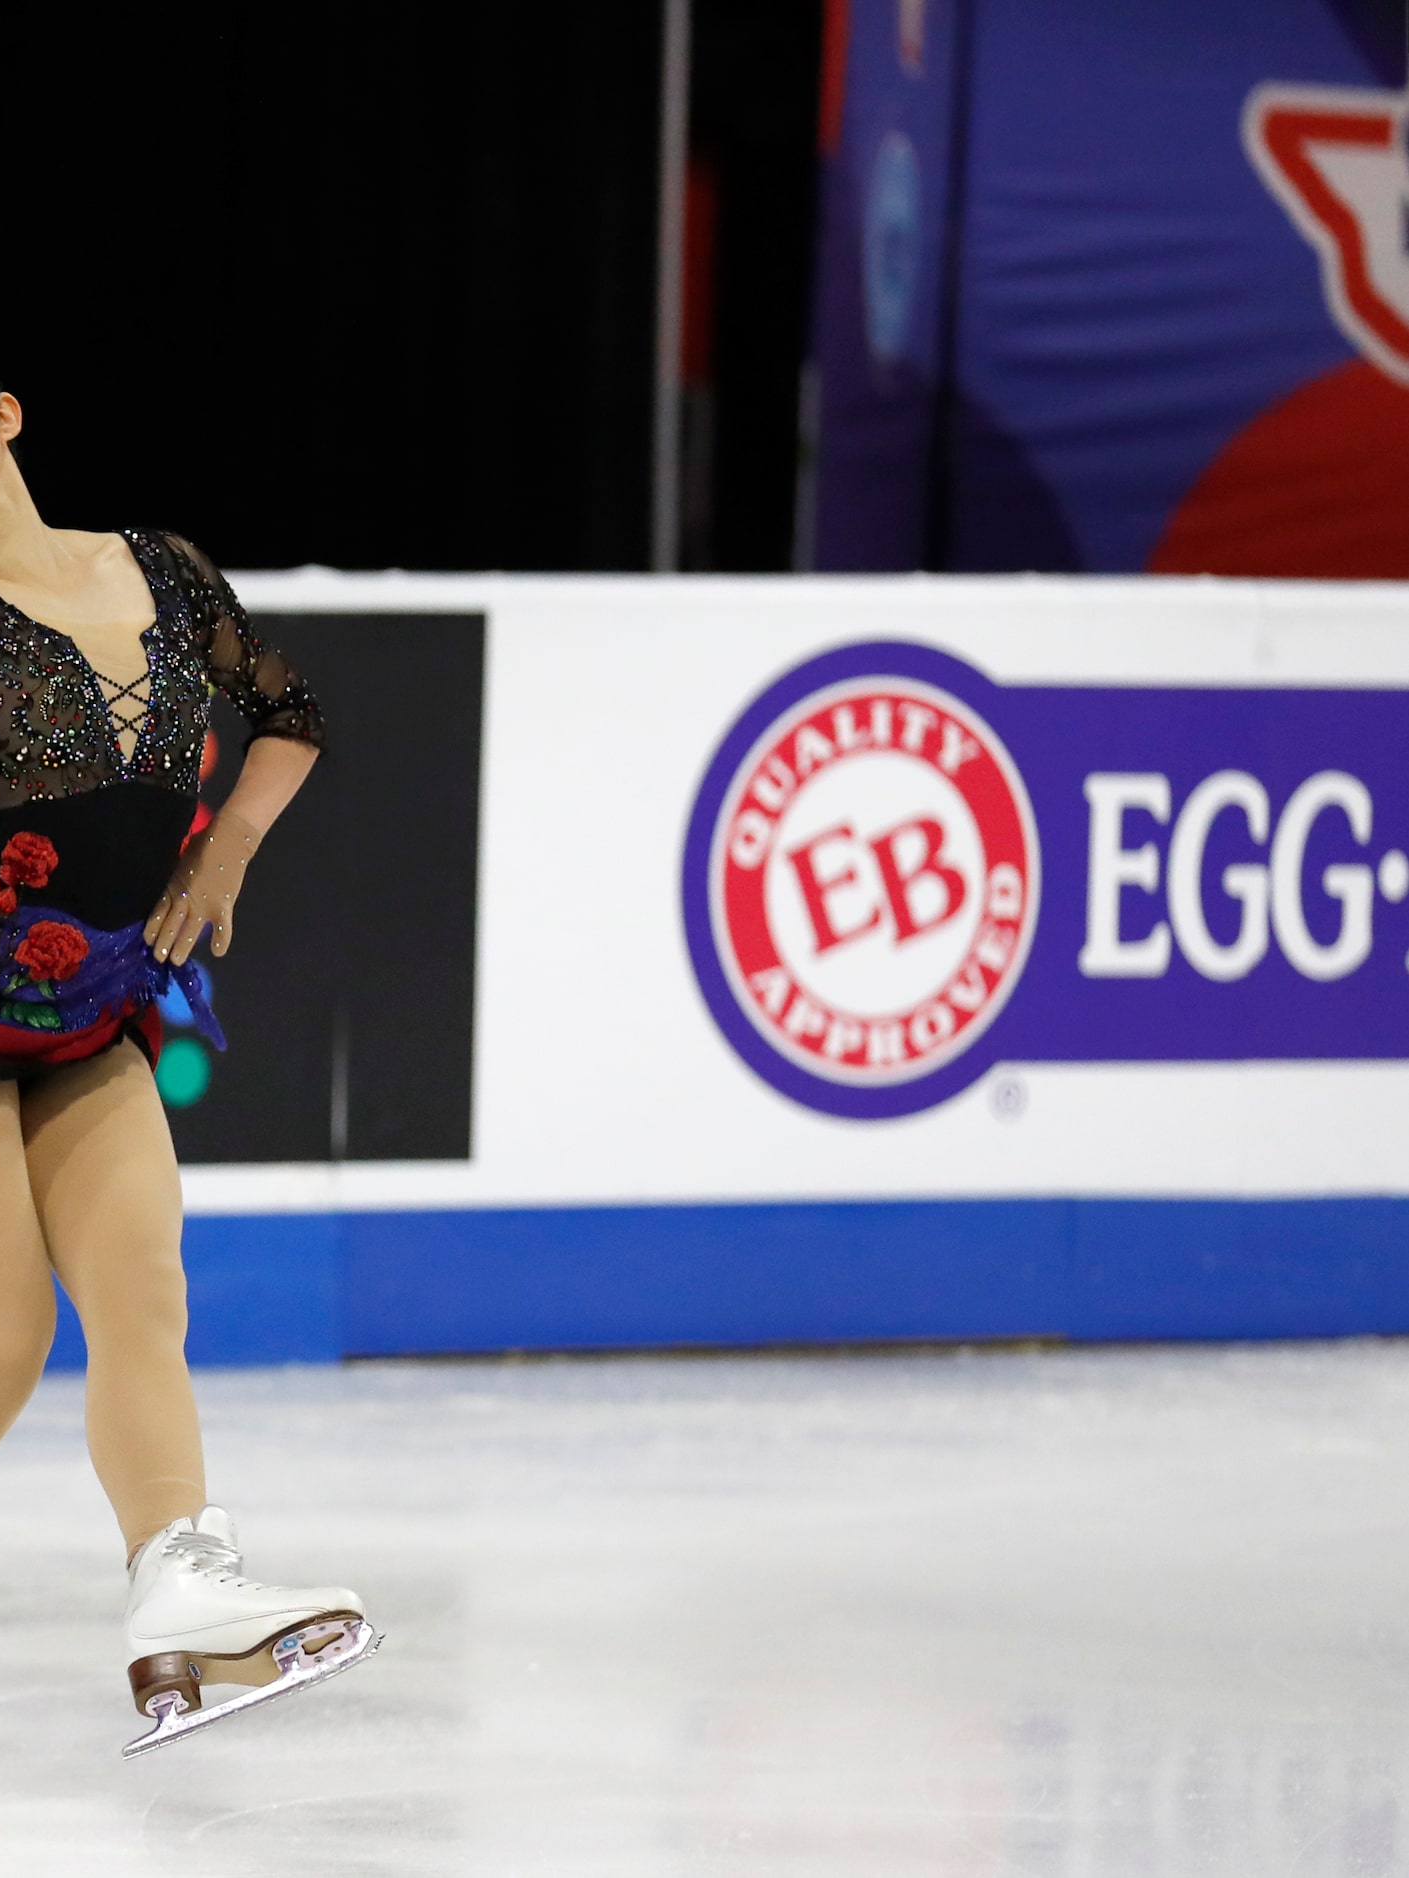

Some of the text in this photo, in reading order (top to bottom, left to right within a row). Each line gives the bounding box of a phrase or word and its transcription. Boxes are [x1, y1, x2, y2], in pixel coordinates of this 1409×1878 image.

[730, 698, 979, 871] QUALITY
[749, 862, 1024, 1066] APPROVED
[786, 811, 968, 962] EB
